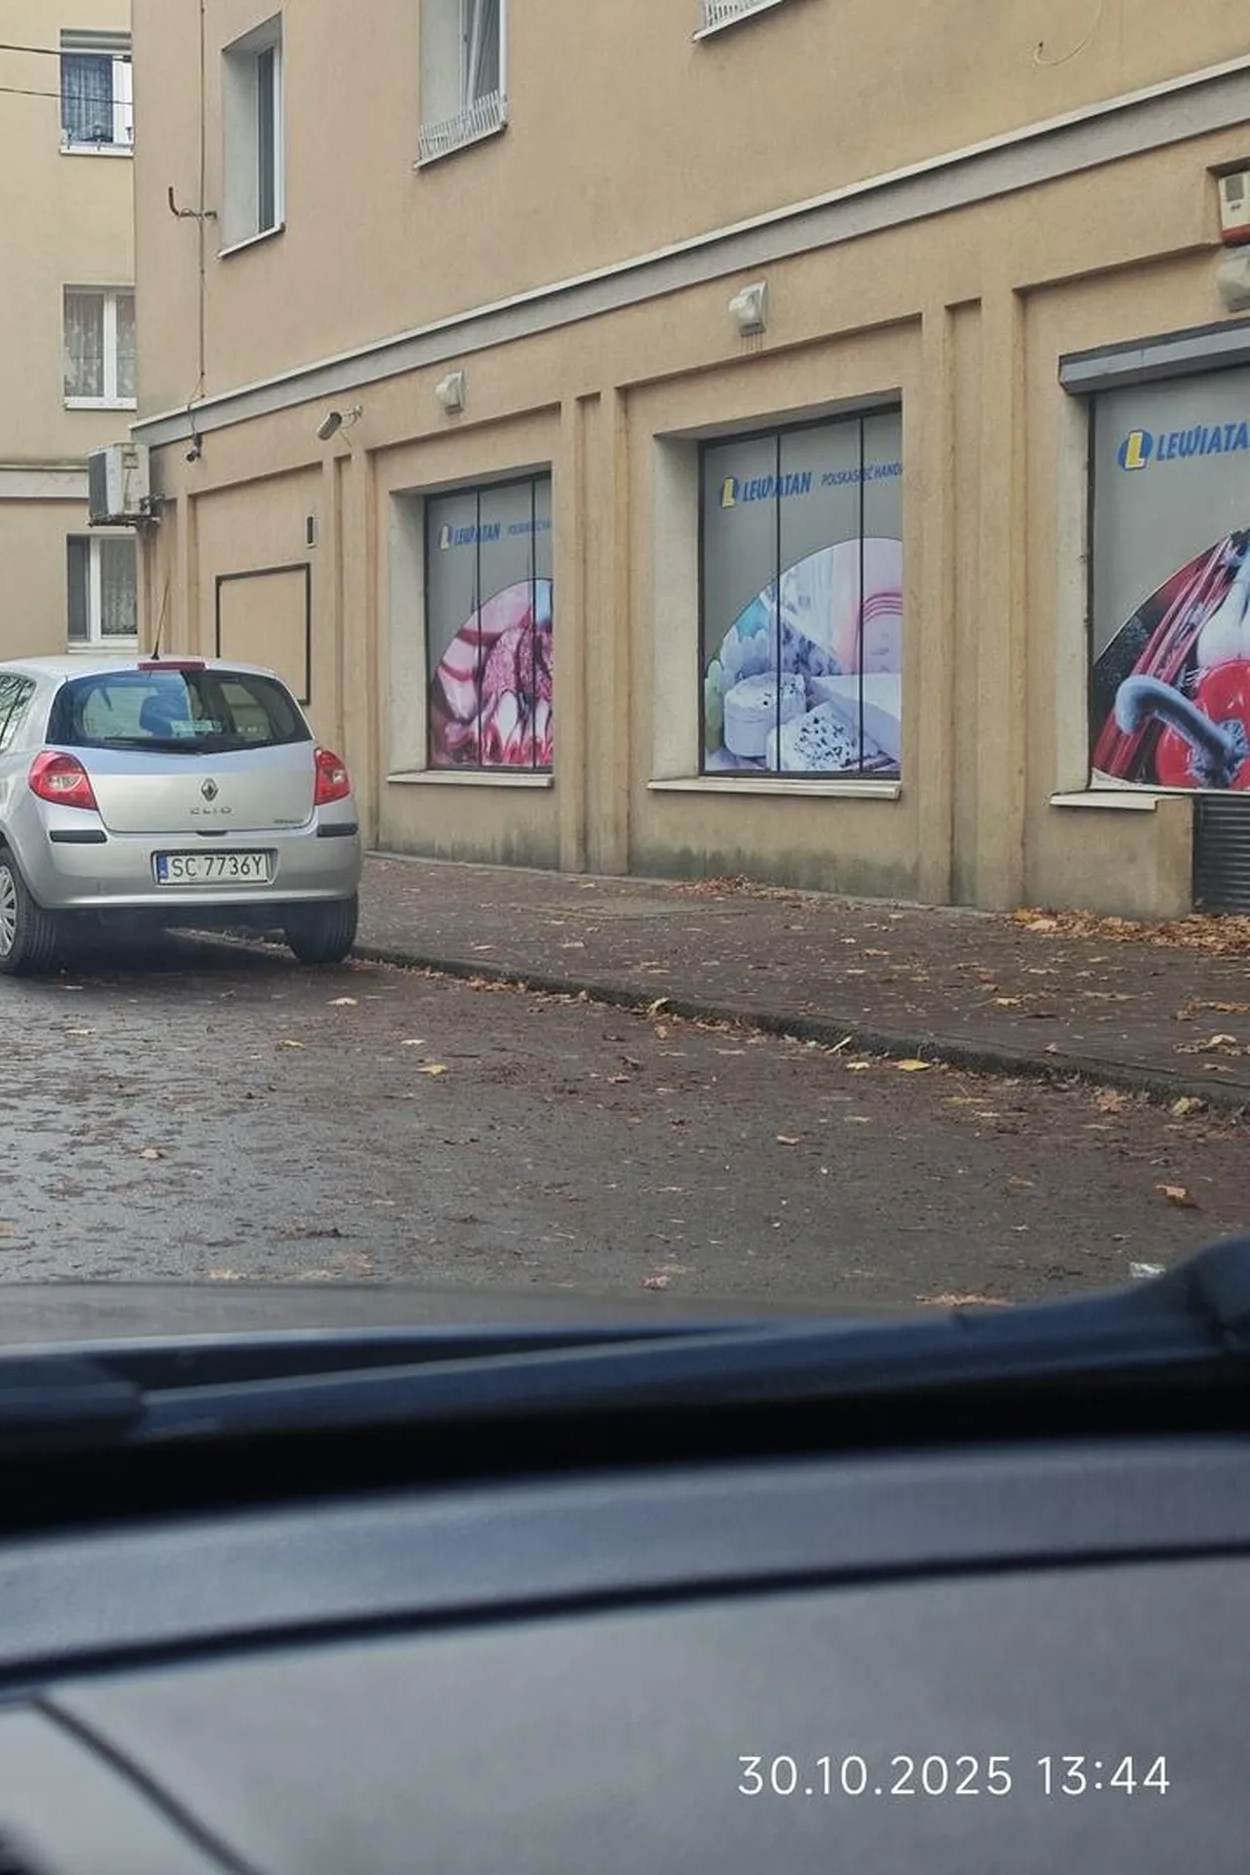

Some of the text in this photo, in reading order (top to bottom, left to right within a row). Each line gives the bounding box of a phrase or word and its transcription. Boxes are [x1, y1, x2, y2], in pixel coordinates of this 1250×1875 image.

[1156, 422, 1250, 462] LEWIATA
[171, 857, 197, 877] SC
[204, 855, 262, 876] 7736Y
